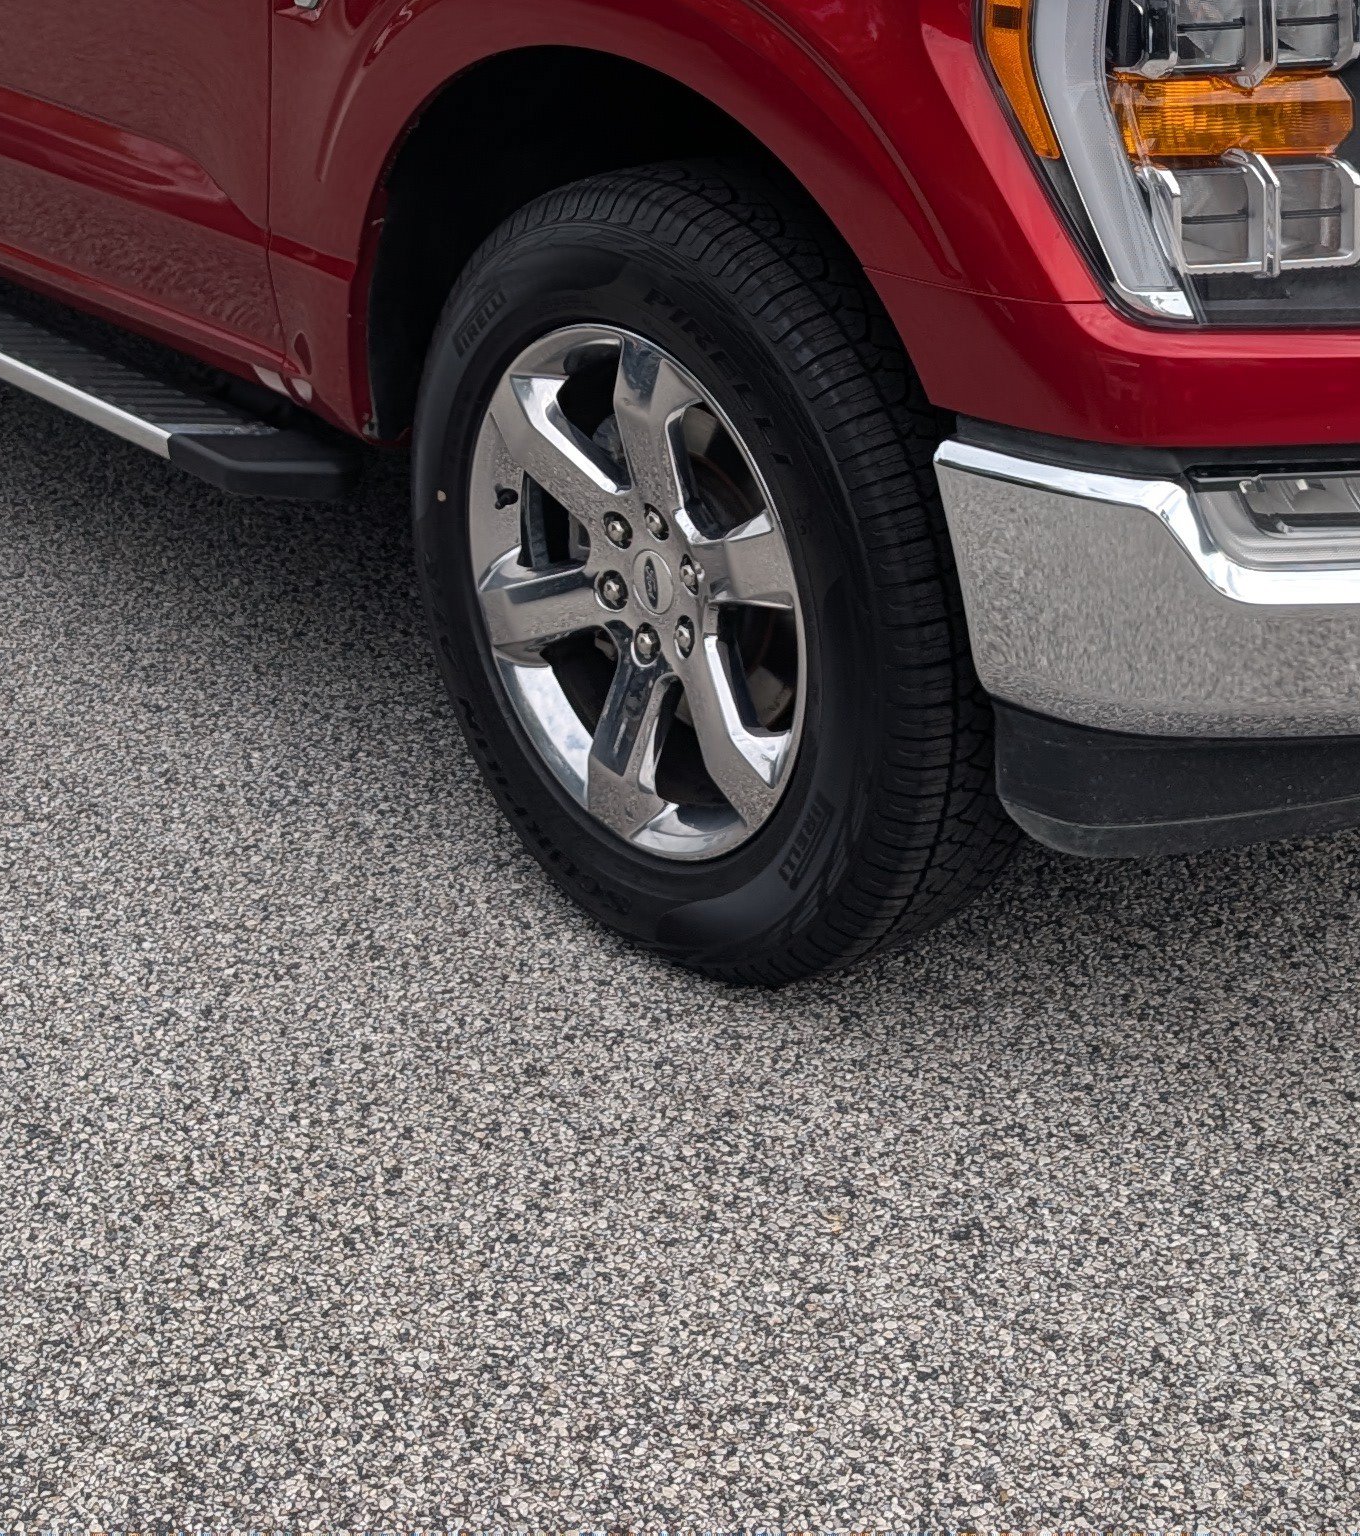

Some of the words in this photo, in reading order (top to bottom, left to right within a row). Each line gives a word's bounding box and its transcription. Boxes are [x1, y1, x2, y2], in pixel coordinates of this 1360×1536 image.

[451, 289, 508, 360] PIRELLI
[642, 286, 794, 466] PIRELLI
[779, 796, 834, 883] PIRELLI
